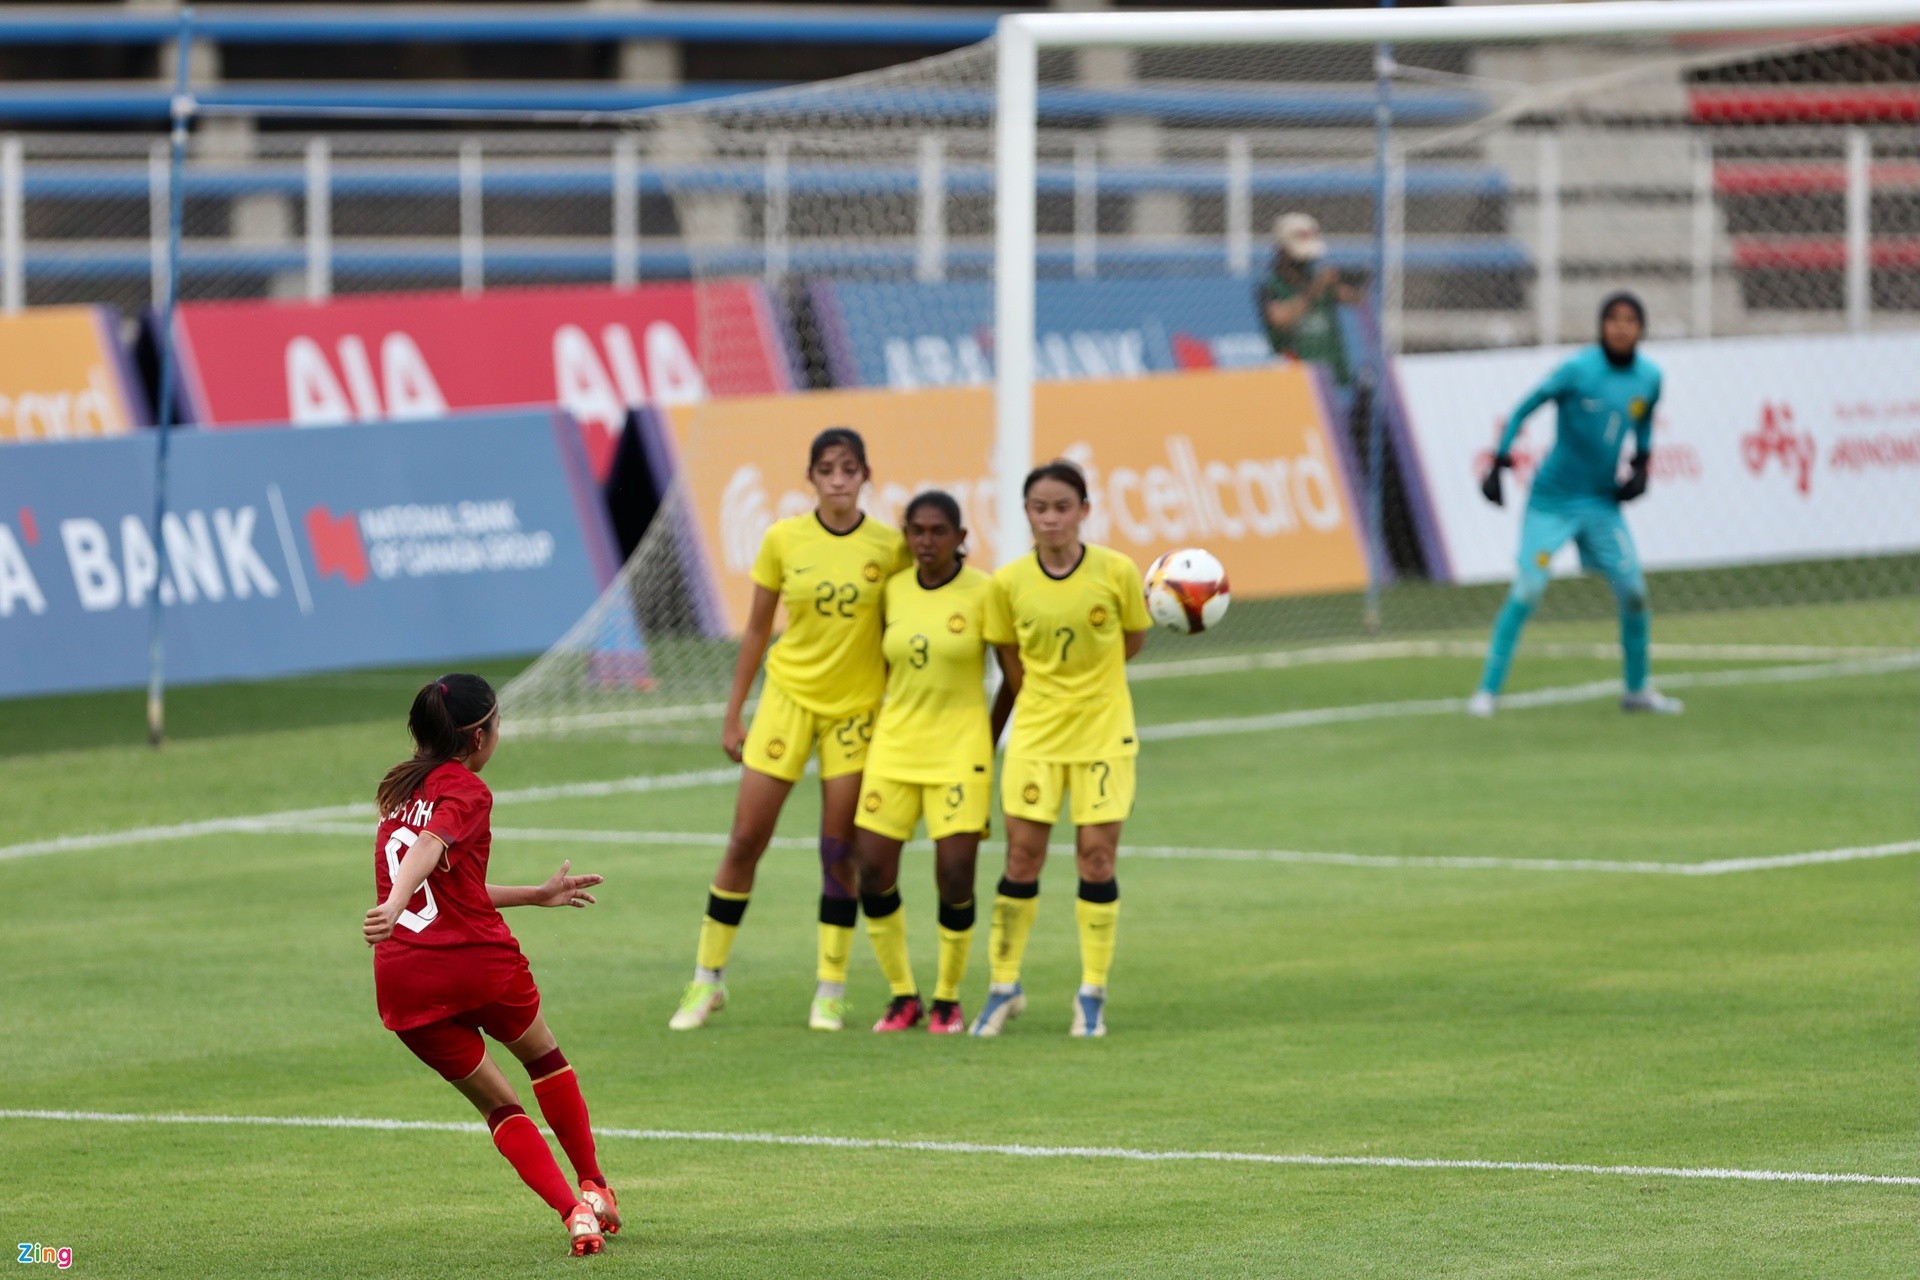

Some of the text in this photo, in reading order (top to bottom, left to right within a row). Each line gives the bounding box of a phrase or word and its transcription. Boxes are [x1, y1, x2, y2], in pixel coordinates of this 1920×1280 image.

[285, 335, 449, 427] AIA
[552, 320, 709, 438] AIA
[1107, 427, 1342, 546] cellcard
[359, 499, 521, 542] NATIONAL BANK
[59, 503, 282, 612] BANK
[371, 529, 555, 580] OF CANADA GROUP
[815, 581, 859, 618] 22
[909, 633, 929, 669] 3
[1055, 627, 1076, 662] 7
[1091, 760, 1111, 797] 7
